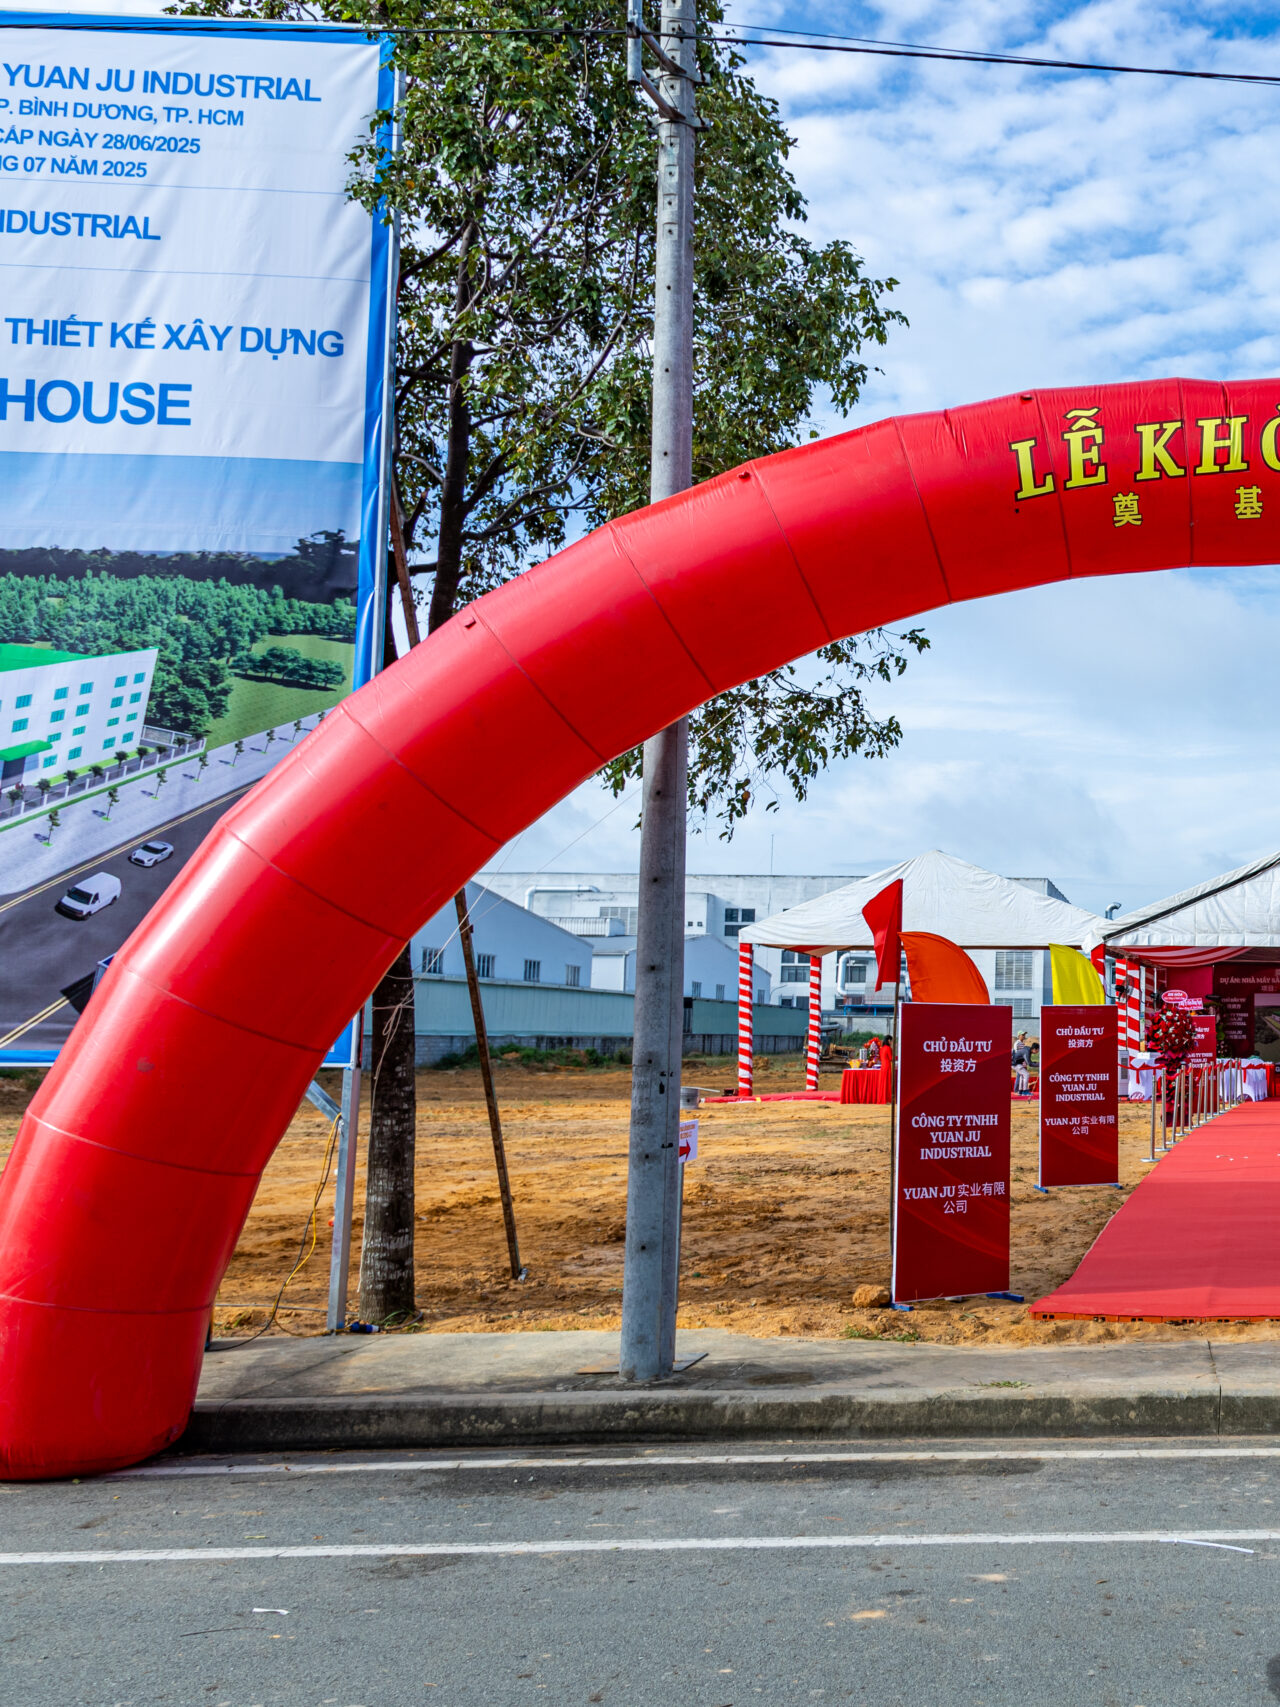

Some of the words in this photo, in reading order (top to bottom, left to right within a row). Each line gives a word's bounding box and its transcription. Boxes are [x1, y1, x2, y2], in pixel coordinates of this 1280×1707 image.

[2, 63, 90, 91] YUAN
[96, 68, 135, 94] JU
[142, 70, 322, 102] INDUSTRIAL
[18, 96, 68, 118] BÌNH
[73, 102, 157, 125] DƯƠNG,
[163, 107, 193, 124] TP.
[199, 109, 244, 126] HCM
[38, 128, 98, 148] NGÀY
[102, 134, 200, 154] 28/06/2025
[0, 155, 19, 172] G
[23, 156, 46, 172] 07
[51, 154, 97, 175] NĂM
[102, 160, 147, 177] 2025
[0, 208, 161, 241] DUSTRIAL
[5, 314, 103, 347] THIẾT
[110, 317, 156, 349] KẾ
[164, 319, 233, 352] XÂY
[240, 327, 345, 360] DỰNG
[0, 377, 192, 426] HOUSE
[1010, 408, 1106, 500] LỄ
[1056, 1025, 1073, 1036] CHỦ
[1092, 1026, 1104, 1036] TƯ
[923, 1036, 948, 1052] CHỦ
[949, 1036, 974, 1052] ĐẦU
[975, 1039, 992, 1052] TƯ
[940, 1058, 977, 1073] 投资方
[1049, 1072, 1072, 1082] CÔNG
[1073, 1074, 1084, 1082] TY
[1085, 1073, 1109, 1081] TNHH
[1062, 1084, 1085, 1092] YUAN
[1086, 1083, 1097, 1091] JU
[1055, 1093, 1105, 1102] INDUSTRIAL
[912, 1112, 945, 1128] CÔNG
[946, 1115, 963, 1127] TY
[964, 1114, 998, 1127] TNHH
[1044, 1118, 1068, 1126] YUAN
[1069, 1117, 1080, 1125] JU
[930, 1131, 964, 1143] YUAN
[965, 1130, 981, 1142] JU
[920, 1146, 992, 1160] INDUSTRIAL
[903, 1186, 938, 1200] YUAN
[940, 1185, 956, 1198] JU
[957, 1181, 1006, 1198] 实业有限
[943, 1200, 968, 1214] 公司
